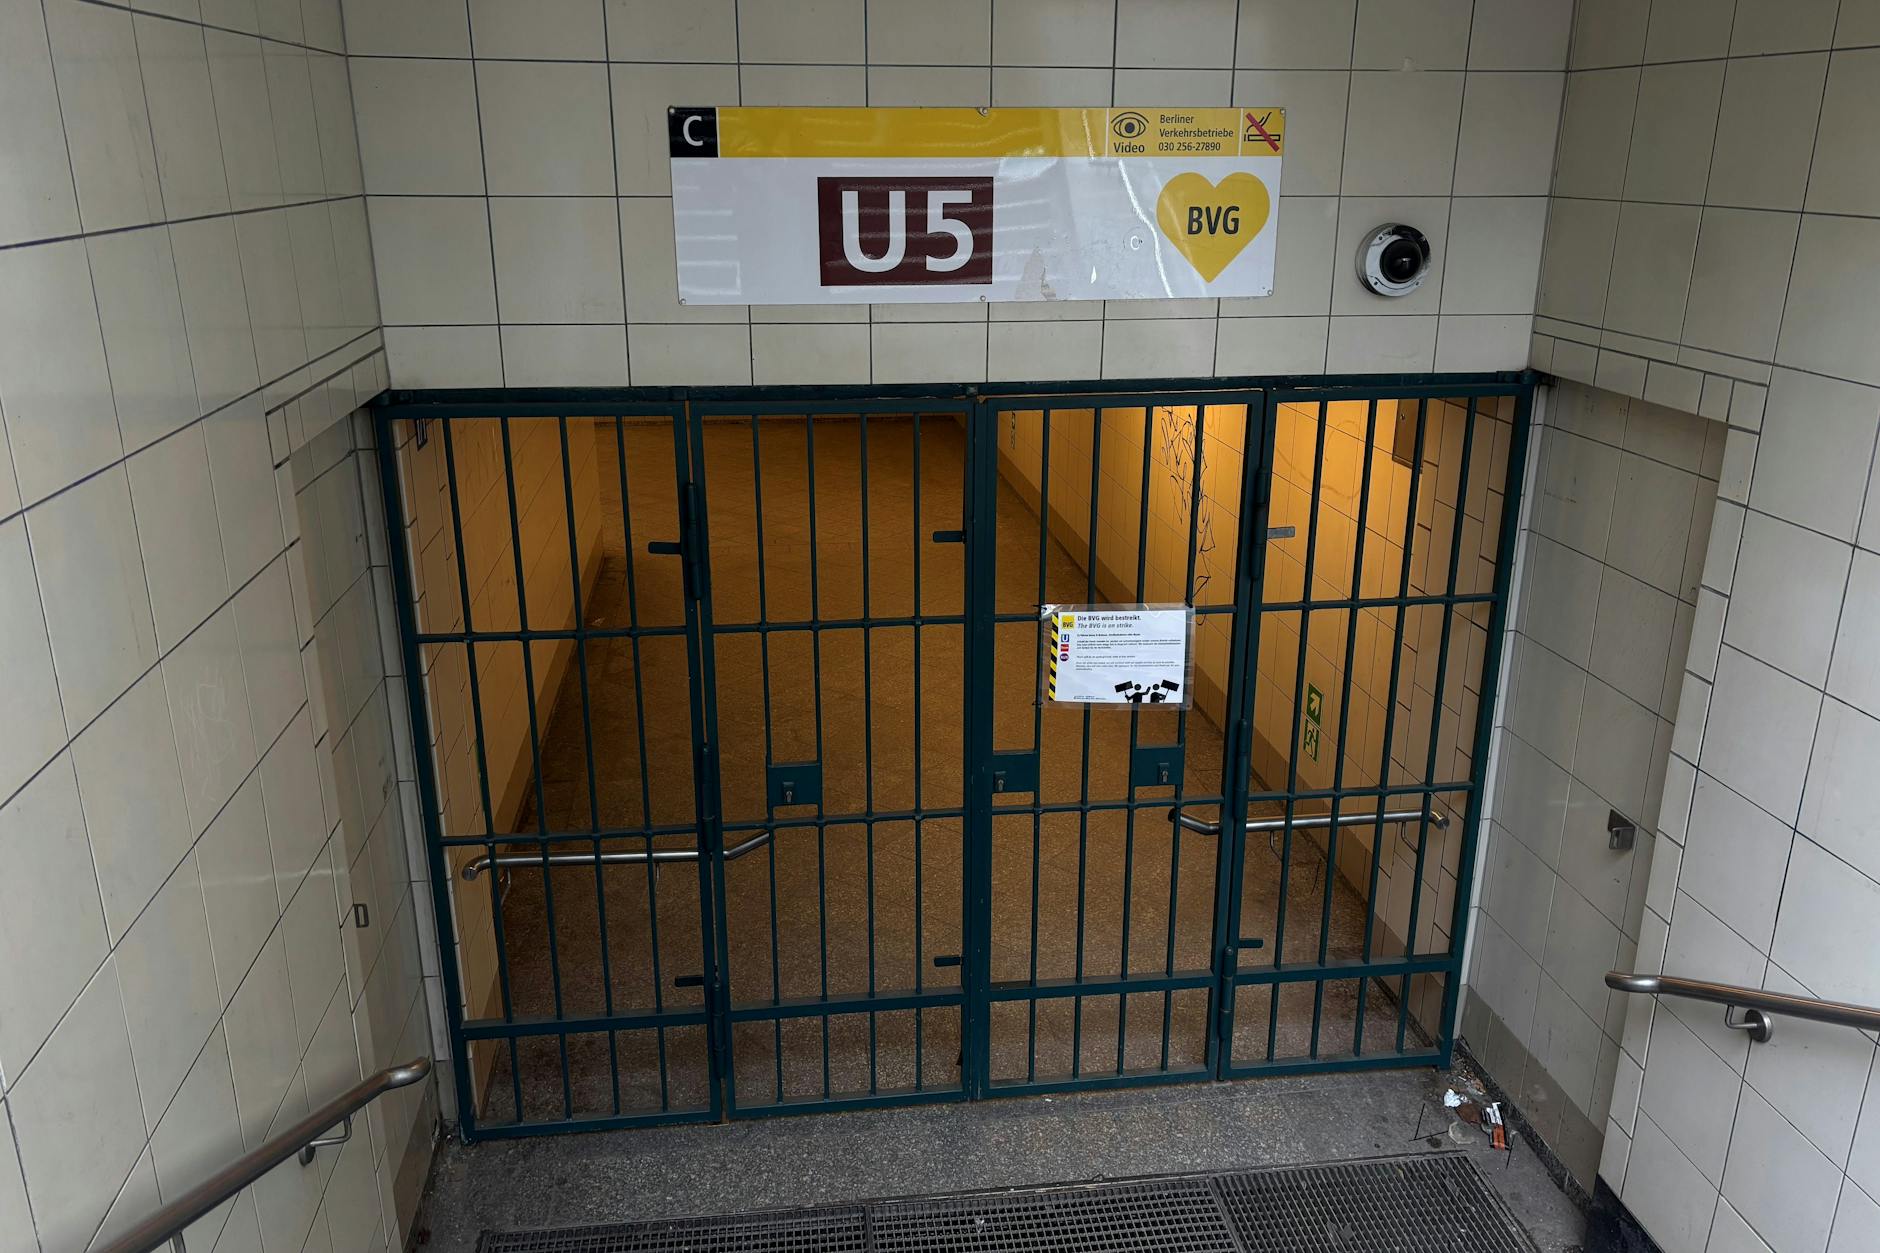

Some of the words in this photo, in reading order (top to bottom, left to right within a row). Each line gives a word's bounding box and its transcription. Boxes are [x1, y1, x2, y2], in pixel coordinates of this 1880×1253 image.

[1160, 114, 1194, 124] Berliner
[683, 115, 704, 147] C
[1160, 128, 1234, 137] Verkehrsbetriebe
[1113, 142, 1145, 153] Video
[1158, 142, 1174, 151] 030
[1176, 142, 1221, 151] 256-27890
[1187, 206, 1240, 235] BVG
[841, 189, 975, 273] U5
